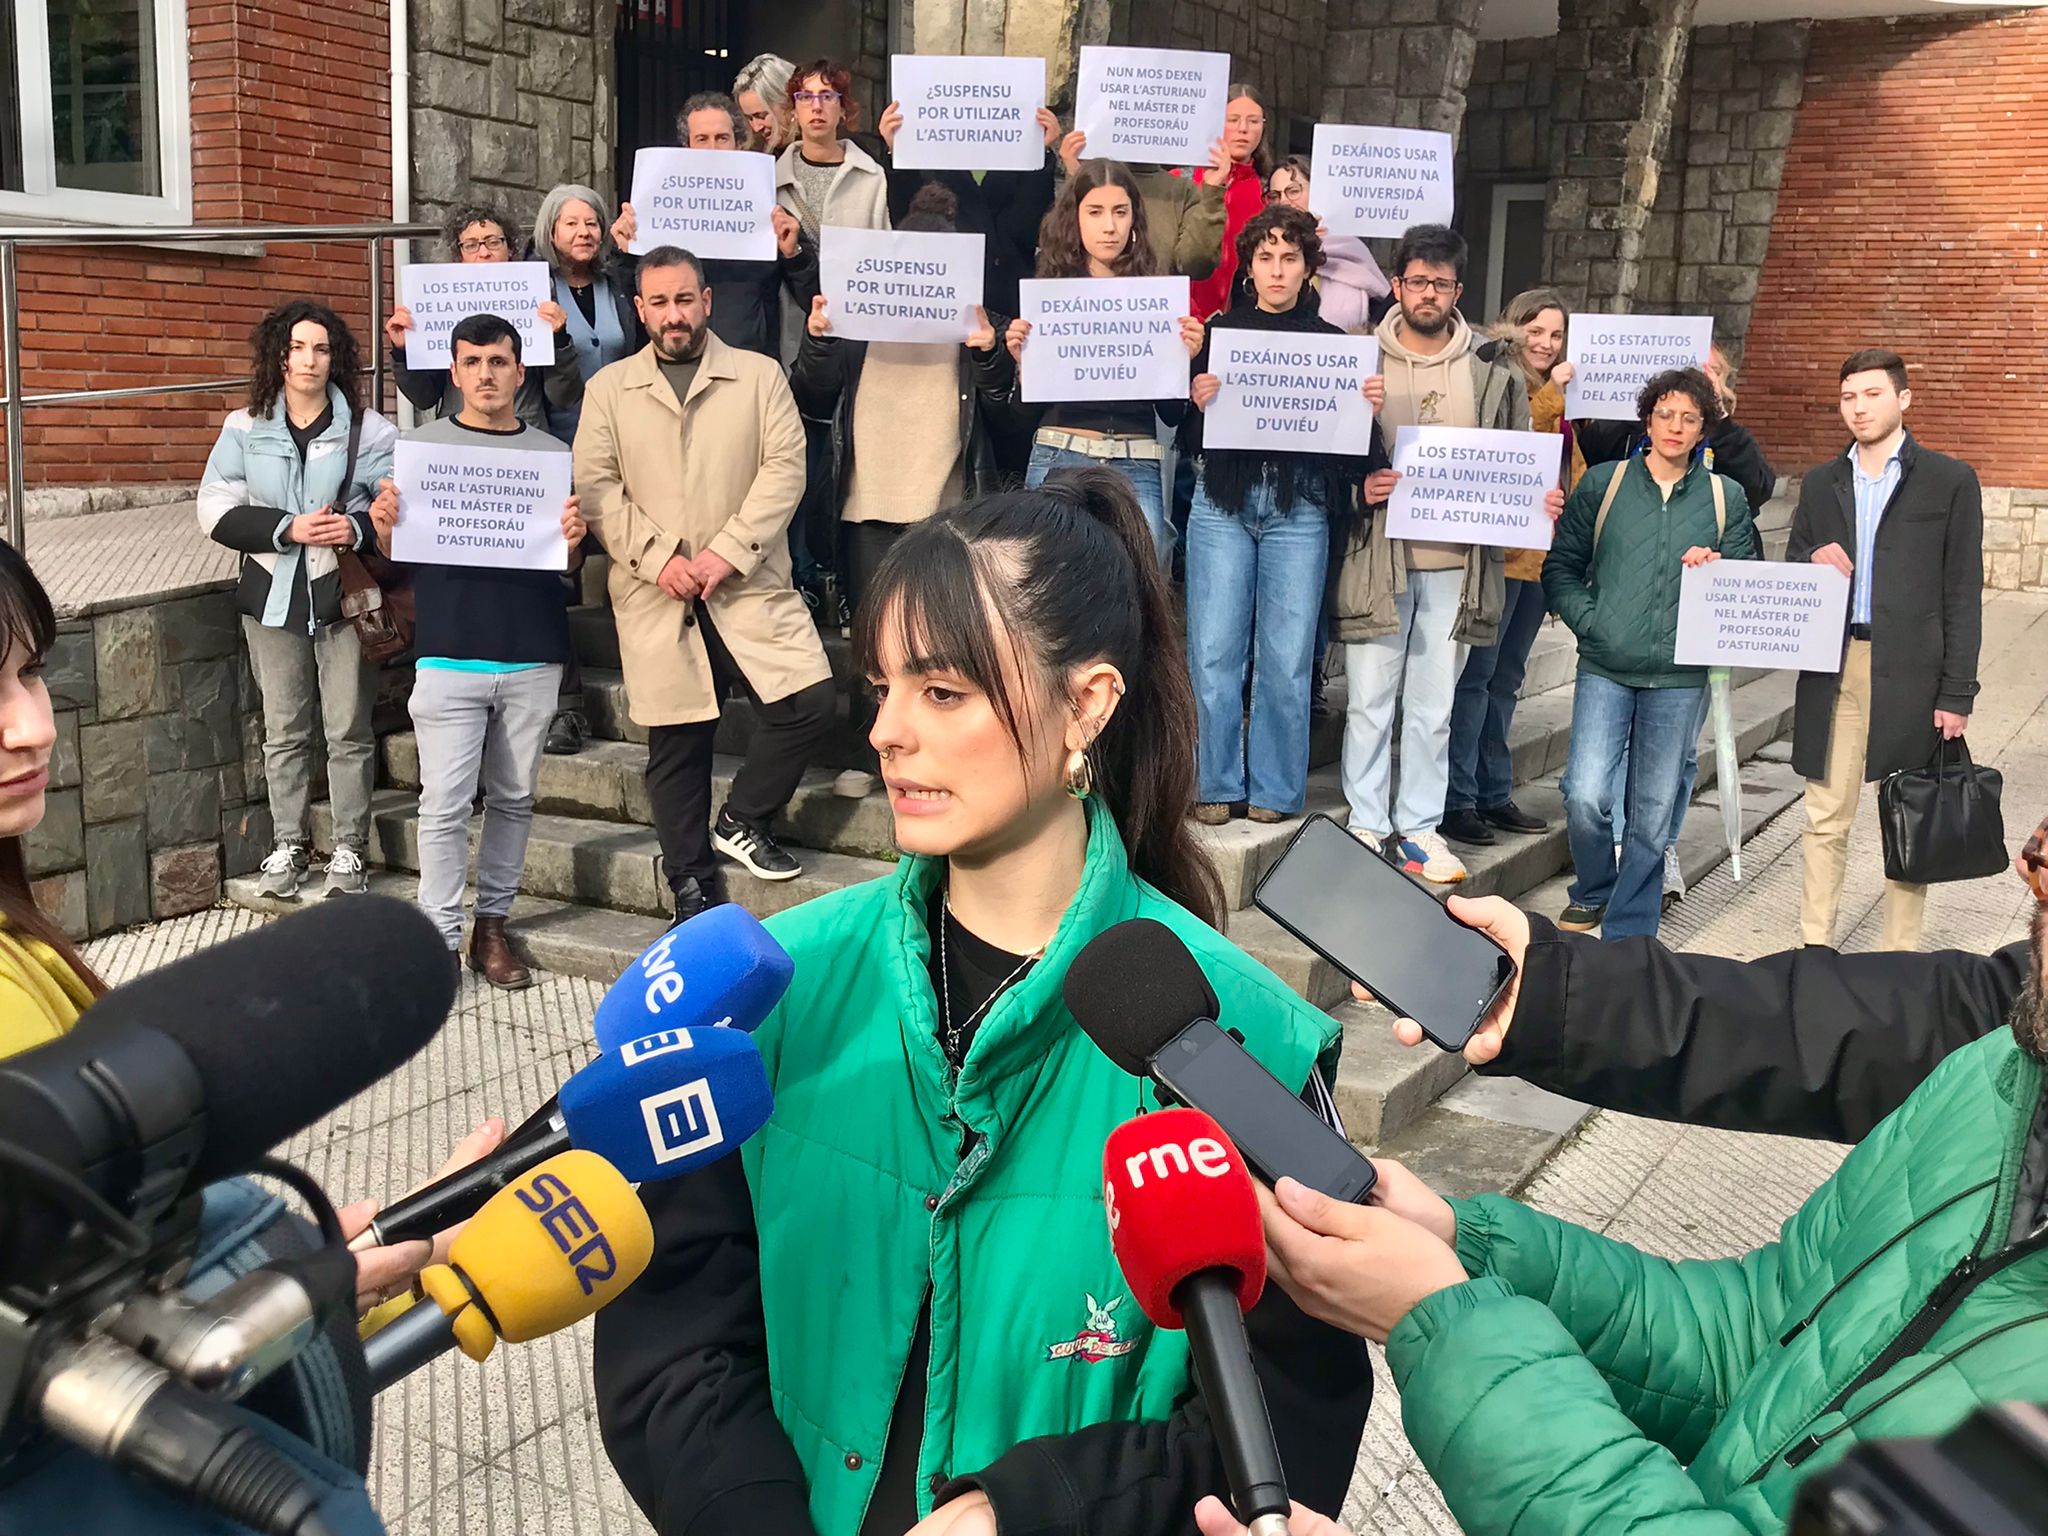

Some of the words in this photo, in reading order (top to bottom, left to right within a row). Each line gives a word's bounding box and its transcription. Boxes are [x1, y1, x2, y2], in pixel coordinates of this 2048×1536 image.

[1106, 66, 1134, 78] NUN
[1136, 68, 1163, 80] MOS
[1165, 69, 1202, 82] DEXEN
[926, 84, 1012, 100] ¿SUSPENSU
[1100, 82, 1130, 94] USAR
[1133, 84, 1207, 98] L’ASTURIANU
[918, 106, 949, 120] POR
[953, 106, 1021, 120] UTILIZAR
[1108, 100, 1131, 111] NEL
[1133, 99, 1179, 114] MÁSTER
[1181, 104, 1196, 114] DE
[1114, 116, 1189, 131] PROFESORÁU
[916, 128, 1023, 143] L’ASTURIANU?
[1112, 133, 1188, 148] D’ASTURIANU
[1332, 142, 1401, 160] DEXÁINOS
[1404, 148, 1438, 162] USAR
[1328, 164, 1417, 180] L’ASTURIANU
[1420, 169, 1440, 182] NA
[661, 175, 744, 191] ¿SUSPENSU
[1342, 186, 1424, 201] UNIVERSIDÁ
[653, 196, 684, 210] POR
[688, 197, 753, 212] UTILIZAR
[1354, 205, 1409, 221] D’UVIÉU
[652, 217, 756, 234] L’ASTURIANU?
[856, 258, 947, 276] ¿SUSPENSU
[423, 282, 449, 294] LOS
[452, 280, 528, 294] ESTATUTOS
[847, 279, 880, 295] POR
[884, 282, 956, 300] UTILIZAR
[415, 302, 433, 313] DE
[436, 301, 454, 313] LA
[456, 296, 539, 312] UNIVERSIDÁ
[845, 301, 958, 321] L’ASTURIANU?
[1041, 296, 1123, 314] DEXÁINOS
[1127, 298, 1169, 312] USAR
[1039, 320, 1144, 336] L’ASTURIANU
[1149, 320, 1172, 334] NA
[1590, 334, 1616, 346] LOS
[1619, 334, 1691, 347] ESTATUTOS
[1058, 340, 1154, 359] UNIVERSIDÁ
[1230, 348, 1312, 367] DEXÁINOS
[1316, 354, 1358, 369] USAR
[1580, 353, 1597, 364] DE
[1600, 353, 1616, 365] LA
[1620, 352, 1698, 367] UNIVERSIDÁ
[1074, 363, 1137, 381] D’UVIÉU
[1584, 372, 1650, 384] AMPAREN
[1226, 372, 1330, 390] L’ASTURIANU
[1334, 377, 1358, 391] NA
[1242, 394, 1338, 412] UNIVERSIDÁ
[1582, 390, 1606, 401] DEL
[1256, 416, 1319, 433] D’UVIÉU
[1418, 446, 1447, 459] LOS
[1451, 447, 1536, 466] ESTATUTOS
[428, 463, 459, 476] NUN
[462, 466, 493, 478] MOS
[496, 468, 540, 481] DEXEN
[1406, 465, 1425, 479] DE
[1429, 466, 1448, 480] LA
[1452, 468, 1544, 487] UNIVERSIDÁ
[420, 480, 456, 493] USAR
[459, 482, 545, 498] L’ASTURIANU
[1410, 486, 1486, 504] AMPAREN
[1490, 492, 1533, 508] L’USU
[432, 498, 457, 510] NEL
[460, 498, 513, 514] MÁSTER
[516, 503, 533, 515] DE
[438, 516, 525, 532] PROFESORÁU
[1410, 507, 1438, 520] DEL
[1442, 509, 1530, 528] ASTURIANU
[437, 534, 525, 550] D’ASTURIANU
[1713, 578, 1741, 588] NUN
[1744, 579, 1773, 590] MOS
[1776, 581, 1817, 592] DEXEN
[1705, 592, 1737, 603] USAR
[1740, 594, 1822, 608] L’ASTURIANU
[1714, 608, 1738, 619] NEL
[1740, 608, 1790, 622] MÁSTER
[1793, 612, 1809, 622] DE
[1719, 624, 1800, 638] PROFESORÁU
[1717, 640, 1800, 653] D’ASTURIANU
[642, 933, 684, 1014] tve
[1125, 1137, 1231, 1189] rne
[514, 1173, 617, 1296] SER
[1091, 1342, 1108, 1353] DE
